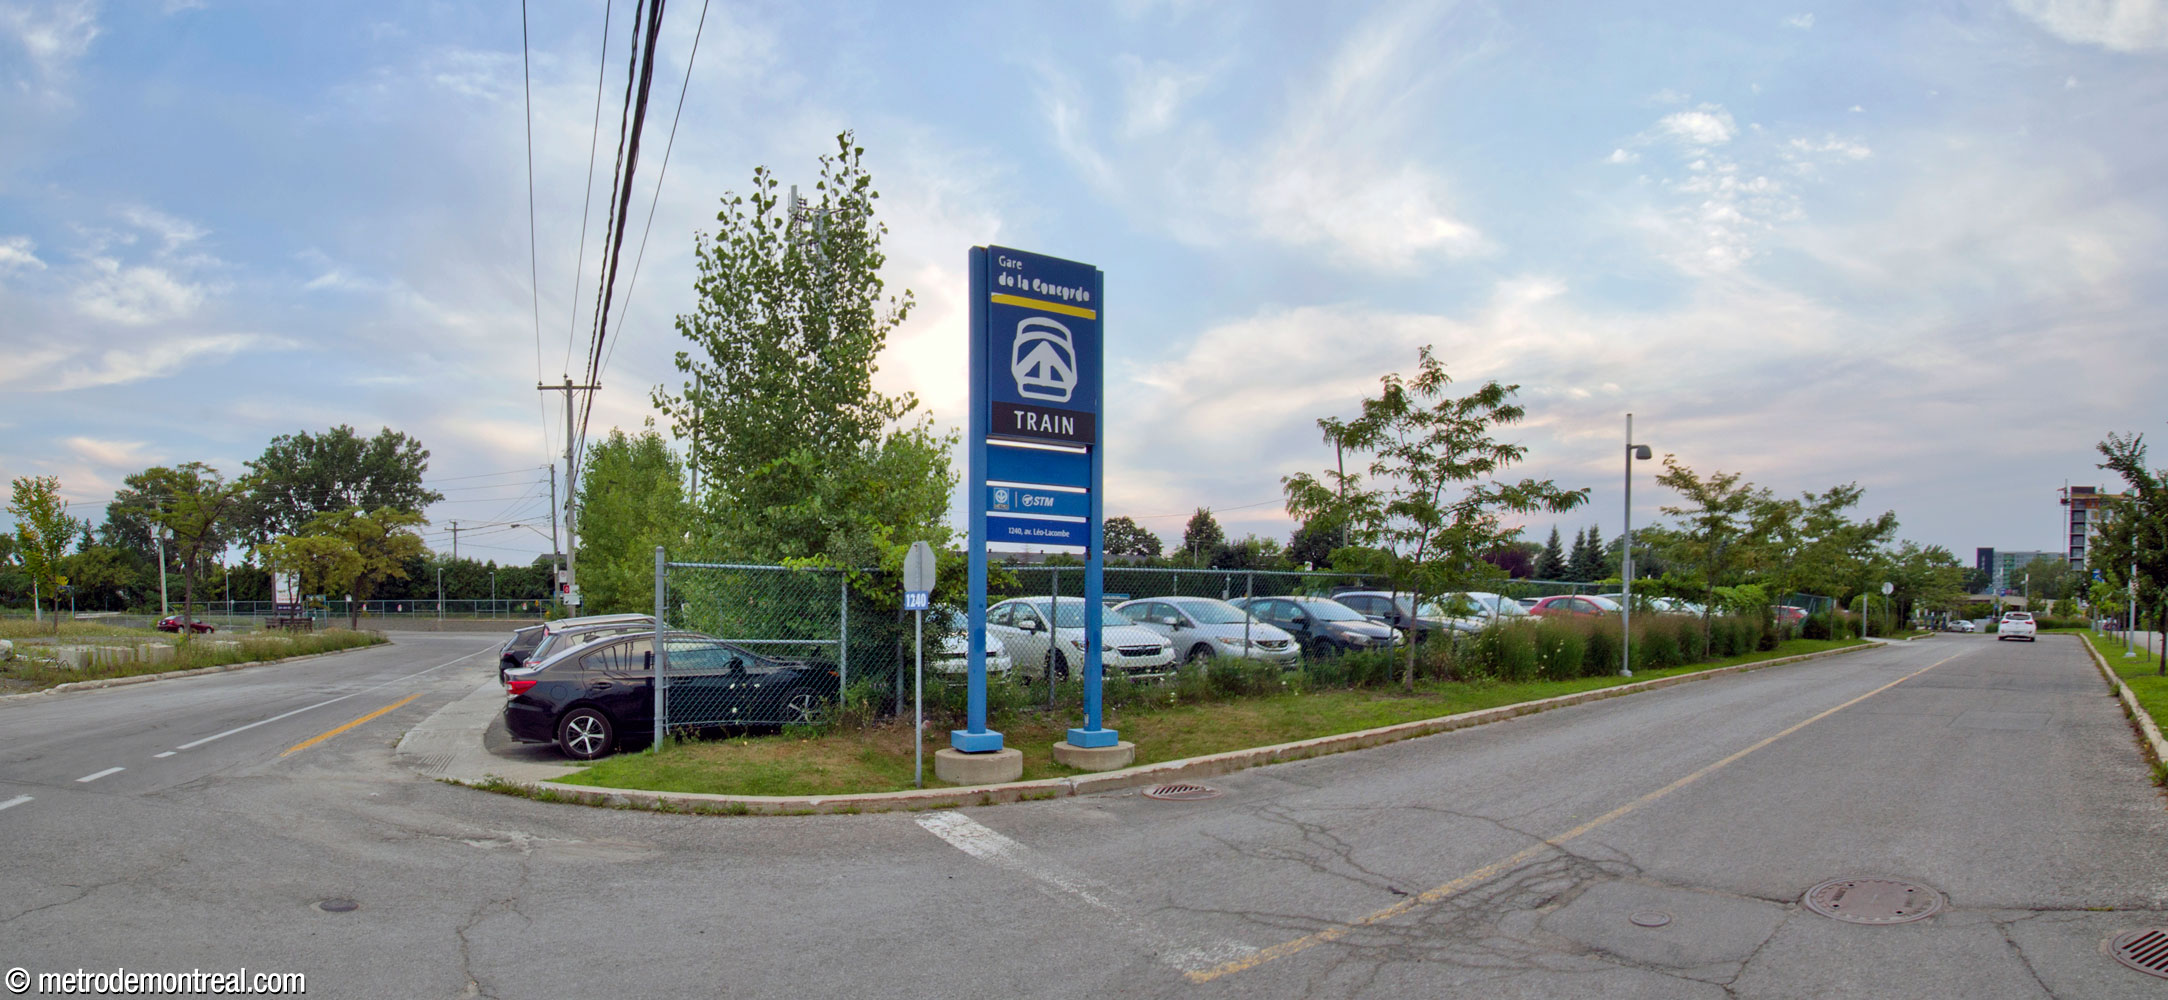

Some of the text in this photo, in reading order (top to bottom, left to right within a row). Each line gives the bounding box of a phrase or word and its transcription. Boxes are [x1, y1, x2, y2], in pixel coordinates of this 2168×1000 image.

[998, 255, 1023, 270] Gare
[998, 271, 1090, 302] de la Concorde
[1013, 410, 1074, 436] TRAIN
[1033, 496, 1054, 506] STM
[1008, 527, 1023, 536] 1240,
[1033, 528, 1070, 537] Léo-Lacombe
[906, 593, 927, 607] 1240
